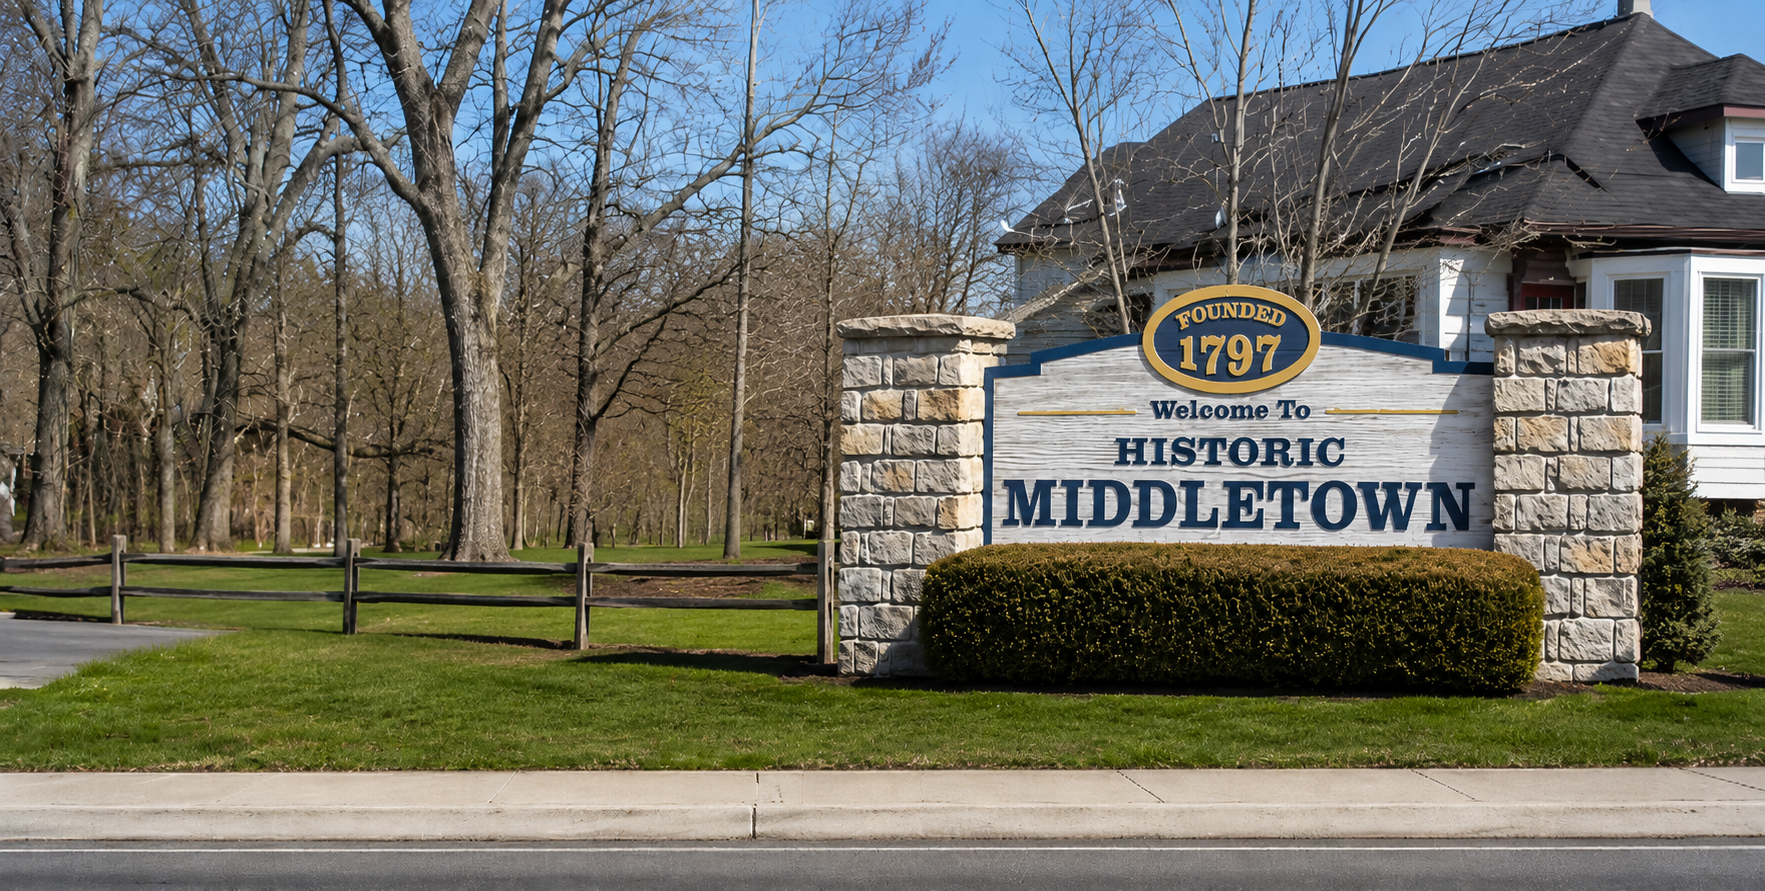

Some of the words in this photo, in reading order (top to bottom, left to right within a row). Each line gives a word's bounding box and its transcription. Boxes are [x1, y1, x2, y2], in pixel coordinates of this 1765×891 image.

[1175, 302, 1287, 331] FOUNDED
[1180, 334, 1281, 377] 1797
[1150, 400, 1269, 420] Welcome
[1277, 400, 1311, 420] To
[1114, 437, 1345, 467] HISTORIC
[1001, 479, 1475, 532] MIDDLETOWN
